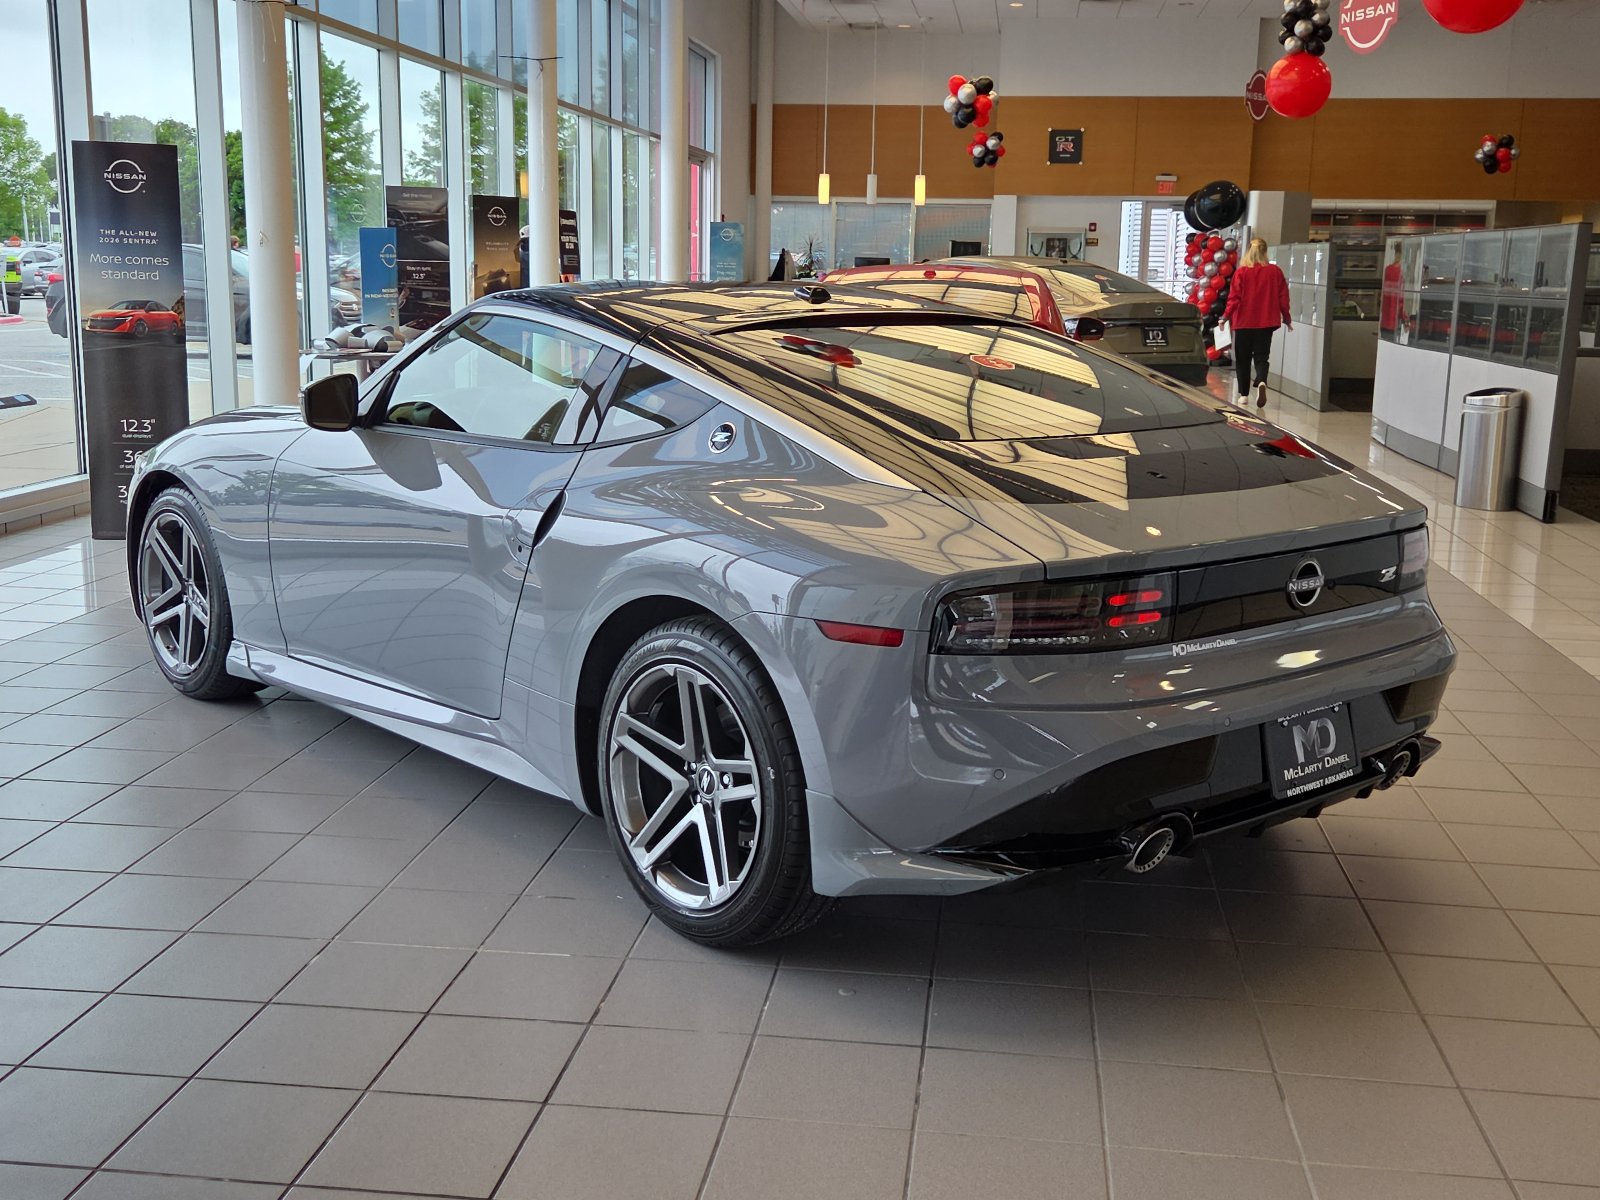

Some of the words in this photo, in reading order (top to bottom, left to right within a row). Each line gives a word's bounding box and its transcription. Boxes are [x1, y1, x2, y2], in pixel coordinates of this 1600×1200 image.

[1341, 2, 1395, 24] NISSAN
[1247, 91, 1266, 101] NISSA
[104, 172, 147, 180] NISSAN
[89, 253, 122, 264] More
[125, 255, 169, 266] comes
[101, 269, 159, 280] standard
[1292, 717, 1336, 764] MD
[1287, 779, 1324, 797] NORTHWEST
[1325, 768, 1354, 785] ARKANSAS
